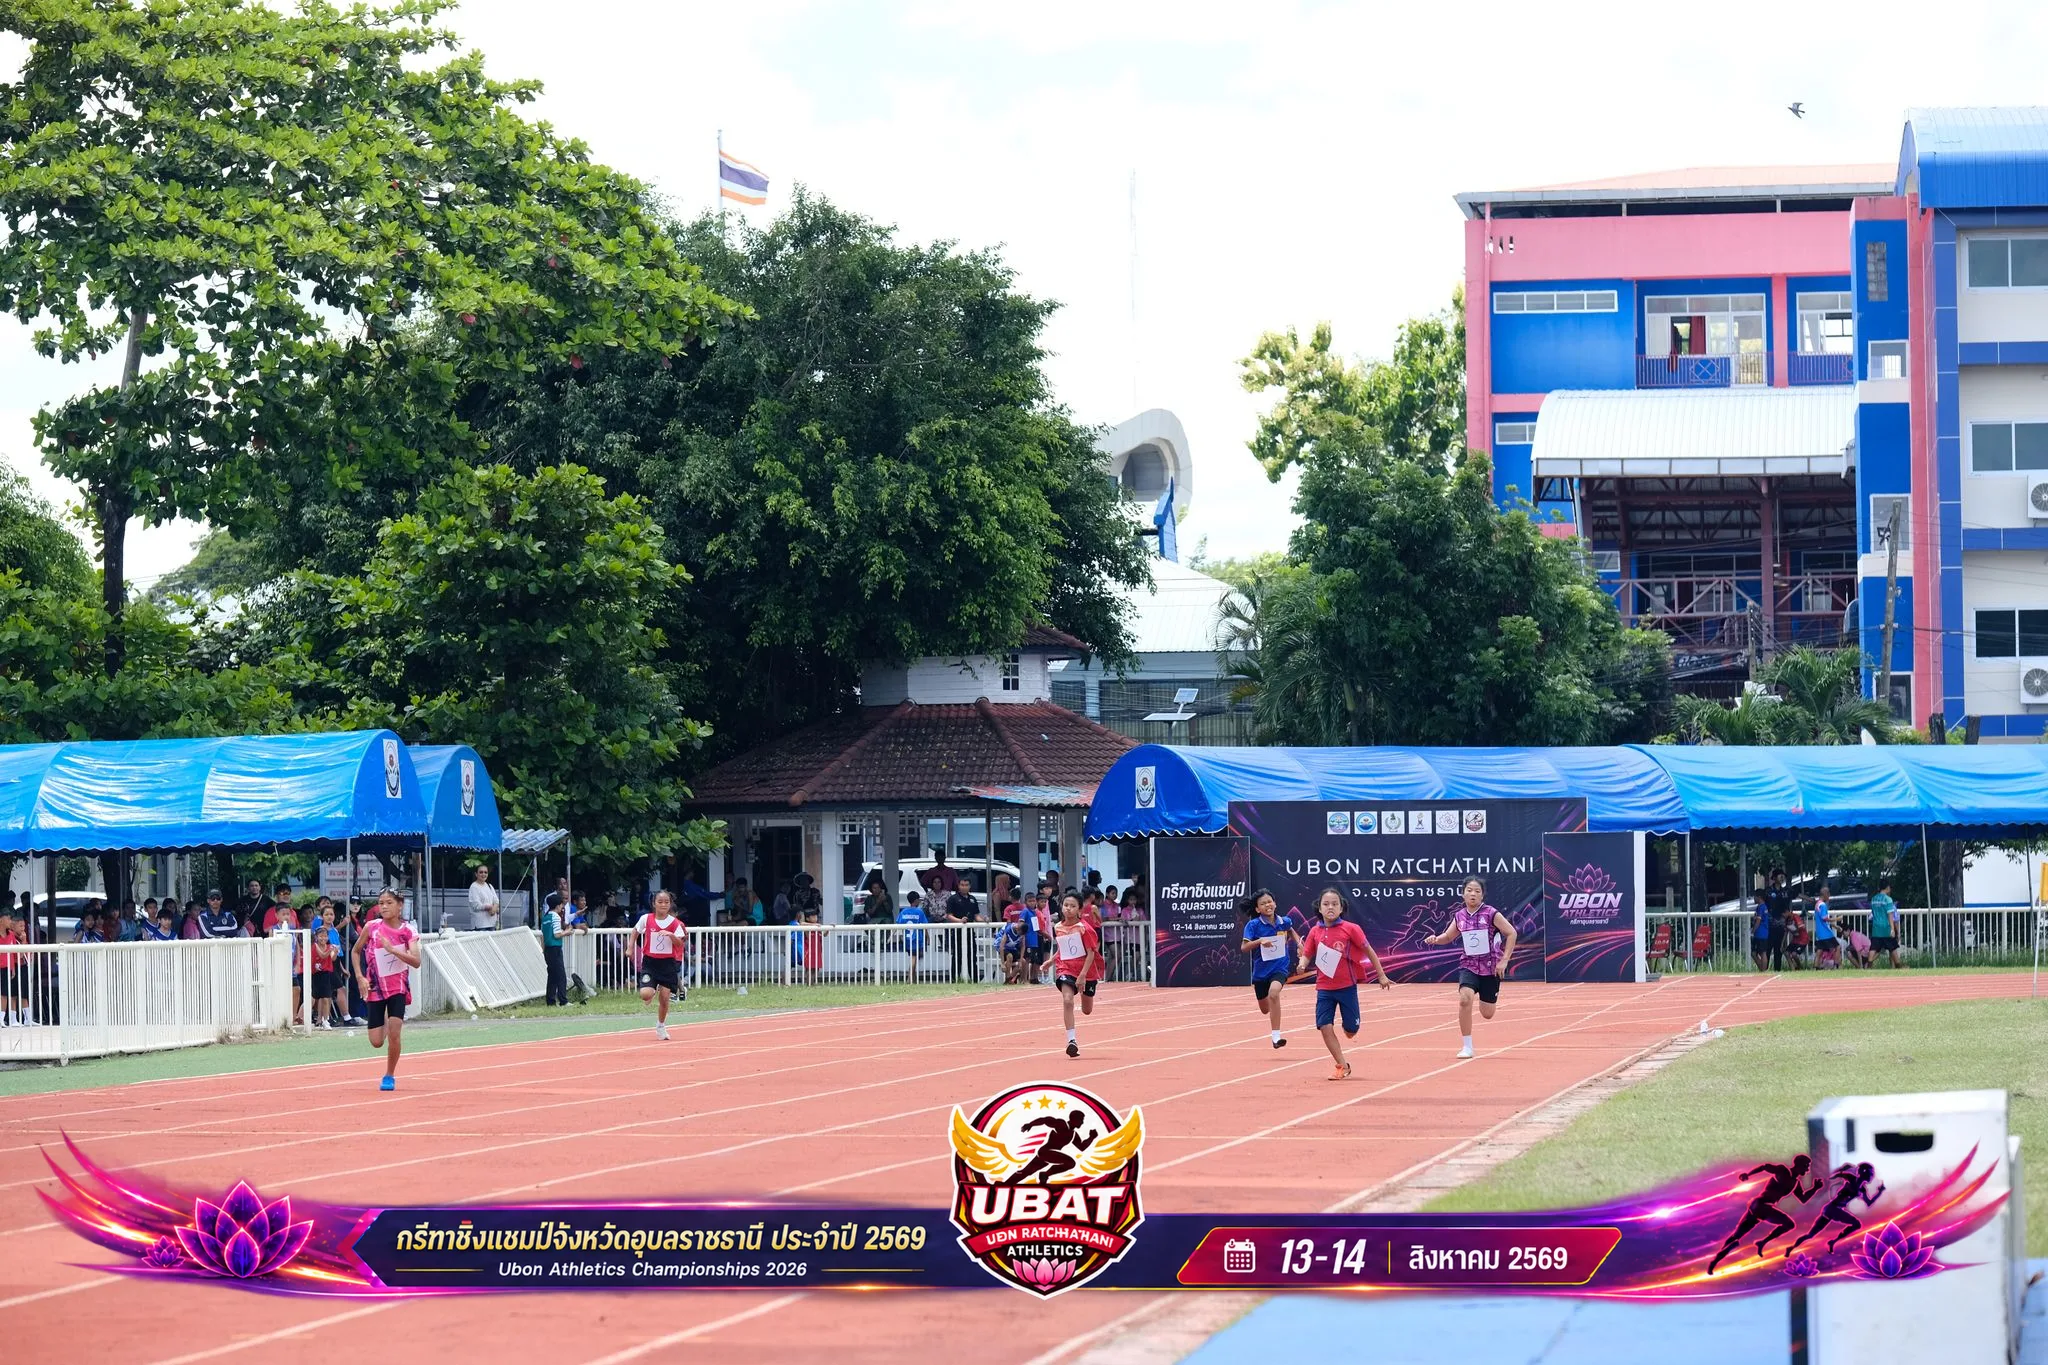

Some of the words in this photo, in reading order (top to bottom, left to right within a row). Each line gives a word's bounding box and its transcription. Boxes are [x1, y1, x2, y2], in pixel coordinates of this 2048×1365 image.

[1286, 858, 1360, 875] UBON
[1372, 856, 1534, 875] RATCHATHANI
[1558, 892, 1623, 909] UBON
[1562, 908, 1619, 918] ATHLETICS
[656, 934, 665, 951] 8
[1068, 936, 1078, 956] 6
[1469, 933, 1480, 948] 3
